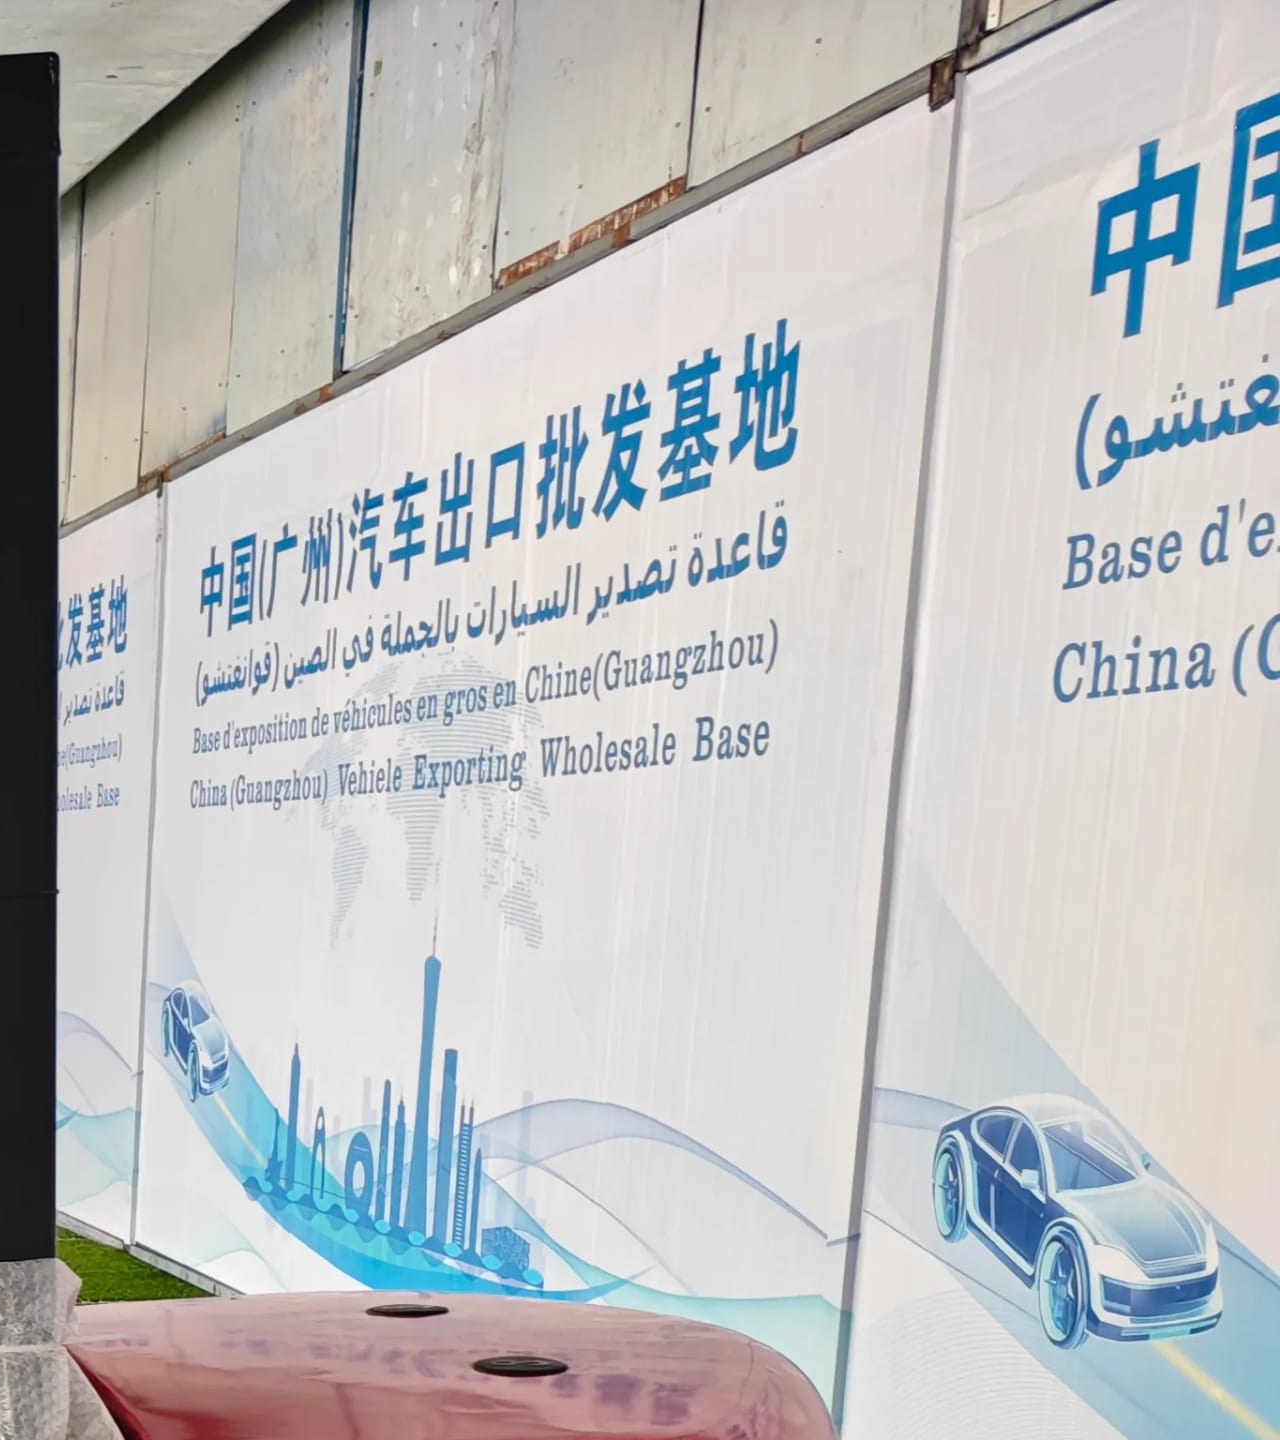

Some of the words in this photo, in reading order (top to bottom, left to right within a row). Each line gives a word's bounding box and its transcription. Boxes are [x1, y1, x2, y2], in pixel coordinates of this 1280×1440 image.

[199, 319, 802, 637] 中国(广州)汽车出口批发基地
[688, 500, 788, 587] قاعدة
[1062, 530, 1182, 590] Base
[467, 562, 581, 646] السيارات
[586, 545, 678, 625] تصدير
[284, 627, 337, 690] الصين
[342, 615, 374, 677] في
[381, 598, 459, 657] بالجملة
[192, 727, 220, 754] Base
[223, 712, 307, 755] d'exposition
[311, 706, 329, 737] de
[333, 694, 412, 733] véhicules
[416, 693, 438, 721] en
[443, 685, 488, 727] gros
[493, 678, 517, 708] en
[525, 618, 779, 703] Chine(Guangzhou)
[1053, 635, 1215, 702] China
[190, 776, 228, 809] China
[230, 769, 329, 812] (Guangzhou)
[338, 758, 402, 797] Vehiele
[412, 745, 527, 800] Exporting
[540, 723, 677, 778] Wholesale
[692, 716, 771, 762] Base
